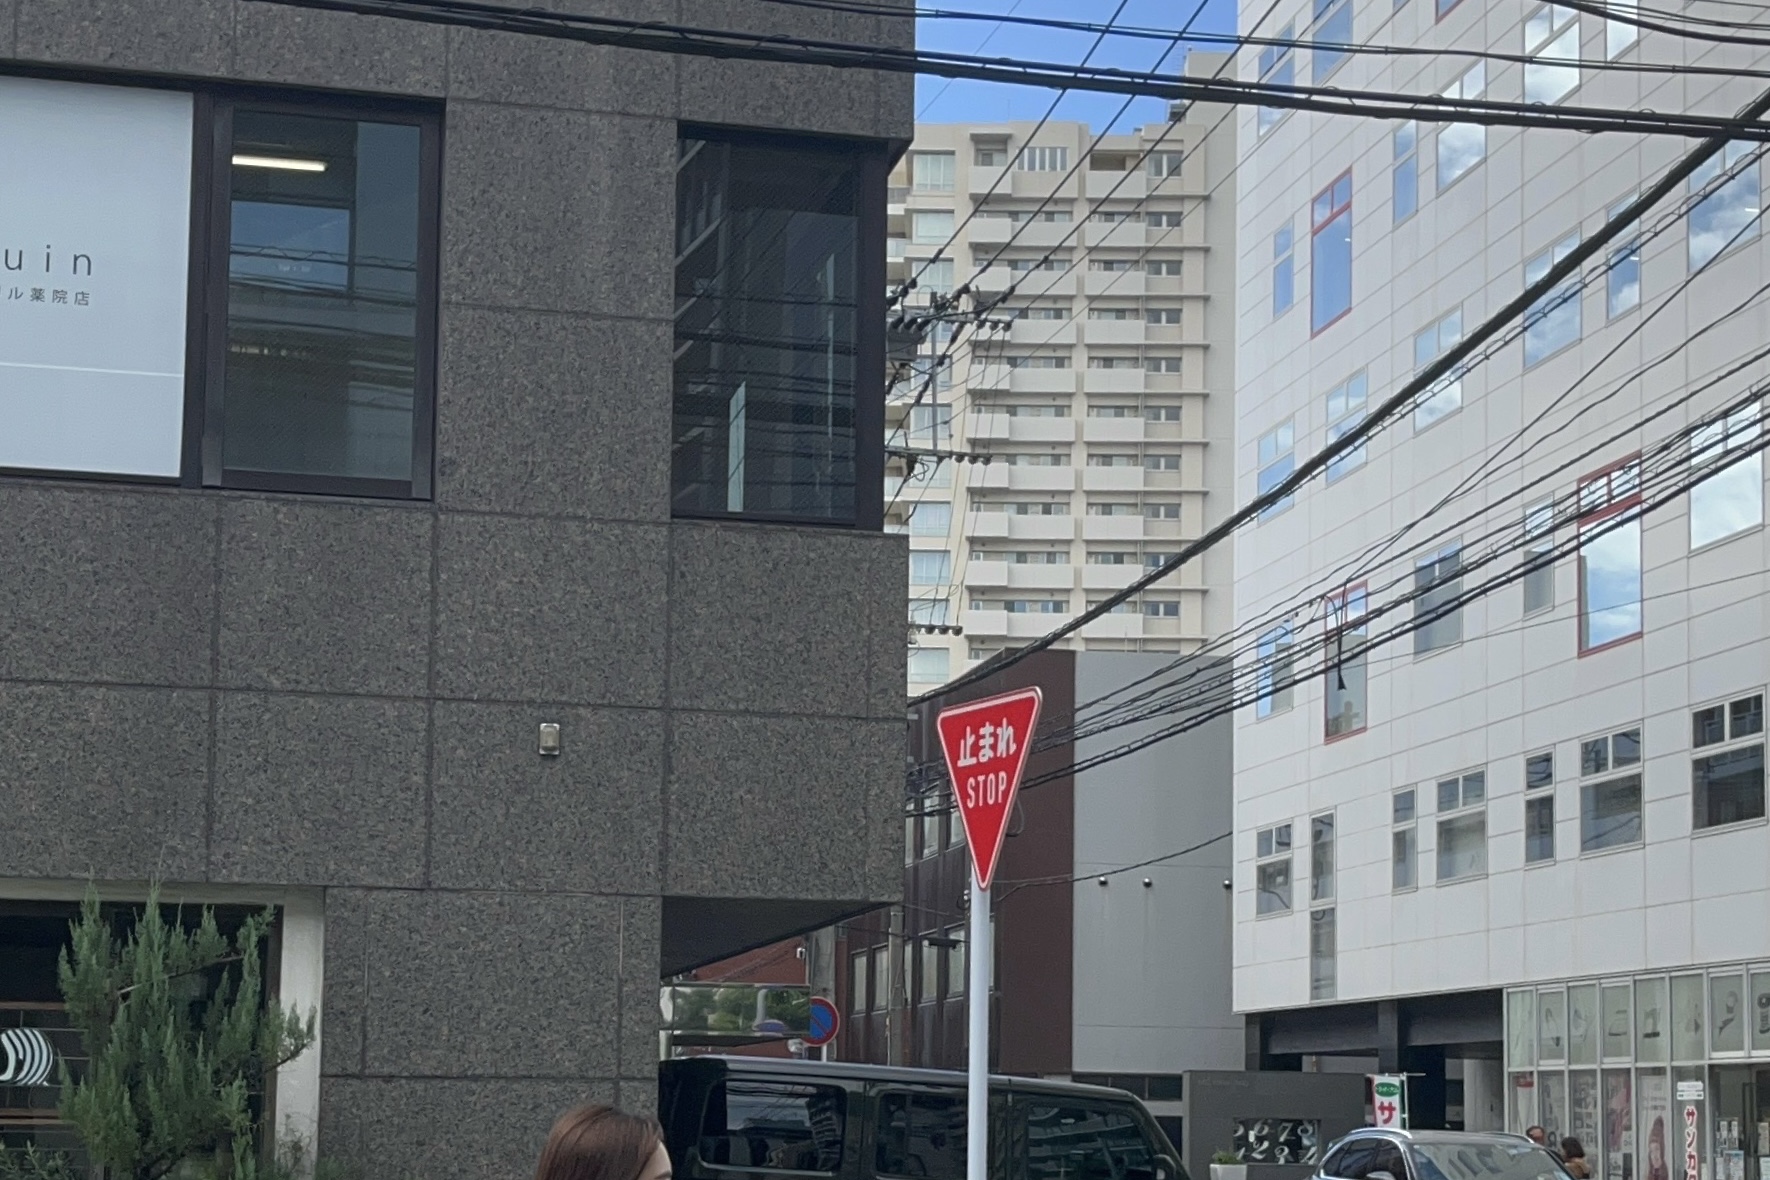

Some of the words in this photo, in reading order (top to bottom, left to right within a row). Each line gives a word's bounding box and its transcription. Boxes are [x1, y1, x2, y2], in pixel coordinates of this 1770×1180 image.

[4, 244, 92, 276] uin
[0, 286, 91, 306] ル薬院店
[957, 716, 1017, 767] 止まれ
[967, 771, 1007, 809] STOP
[1378, 1101, 1396, 1124] サ
